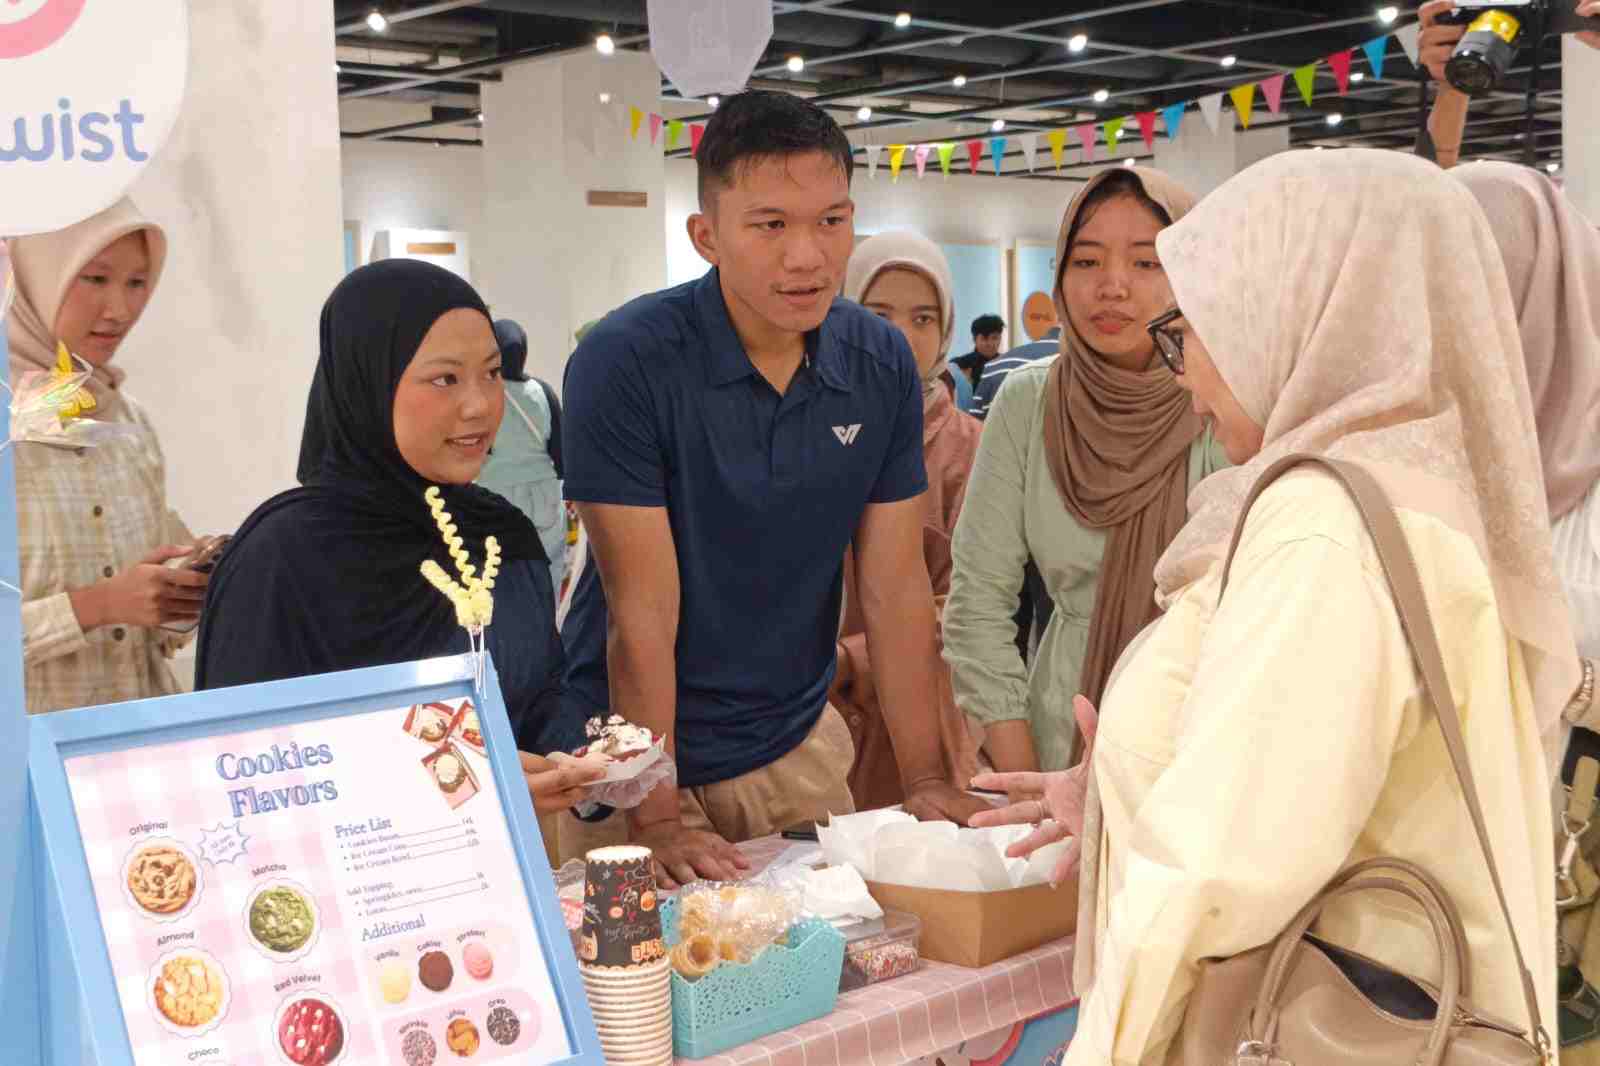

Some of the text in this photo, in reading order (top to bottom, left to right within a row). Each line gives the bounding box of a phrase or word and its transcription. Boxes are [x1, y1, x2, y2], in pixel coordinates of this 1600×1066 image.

[215, 742, 334, 780] Cookies
[227, 780, 338, 818] Flavors
[129, 820, 169, 836] Original
[334, 824, 368, 839] Price
[367, 817, 392, 832] List
[252, 863, 288, 877] Matcha
[361, 913, 425, 942] Additional
[157, 931, 195, 946] Almond
[273, 974, 321, 992] Red Velvet
